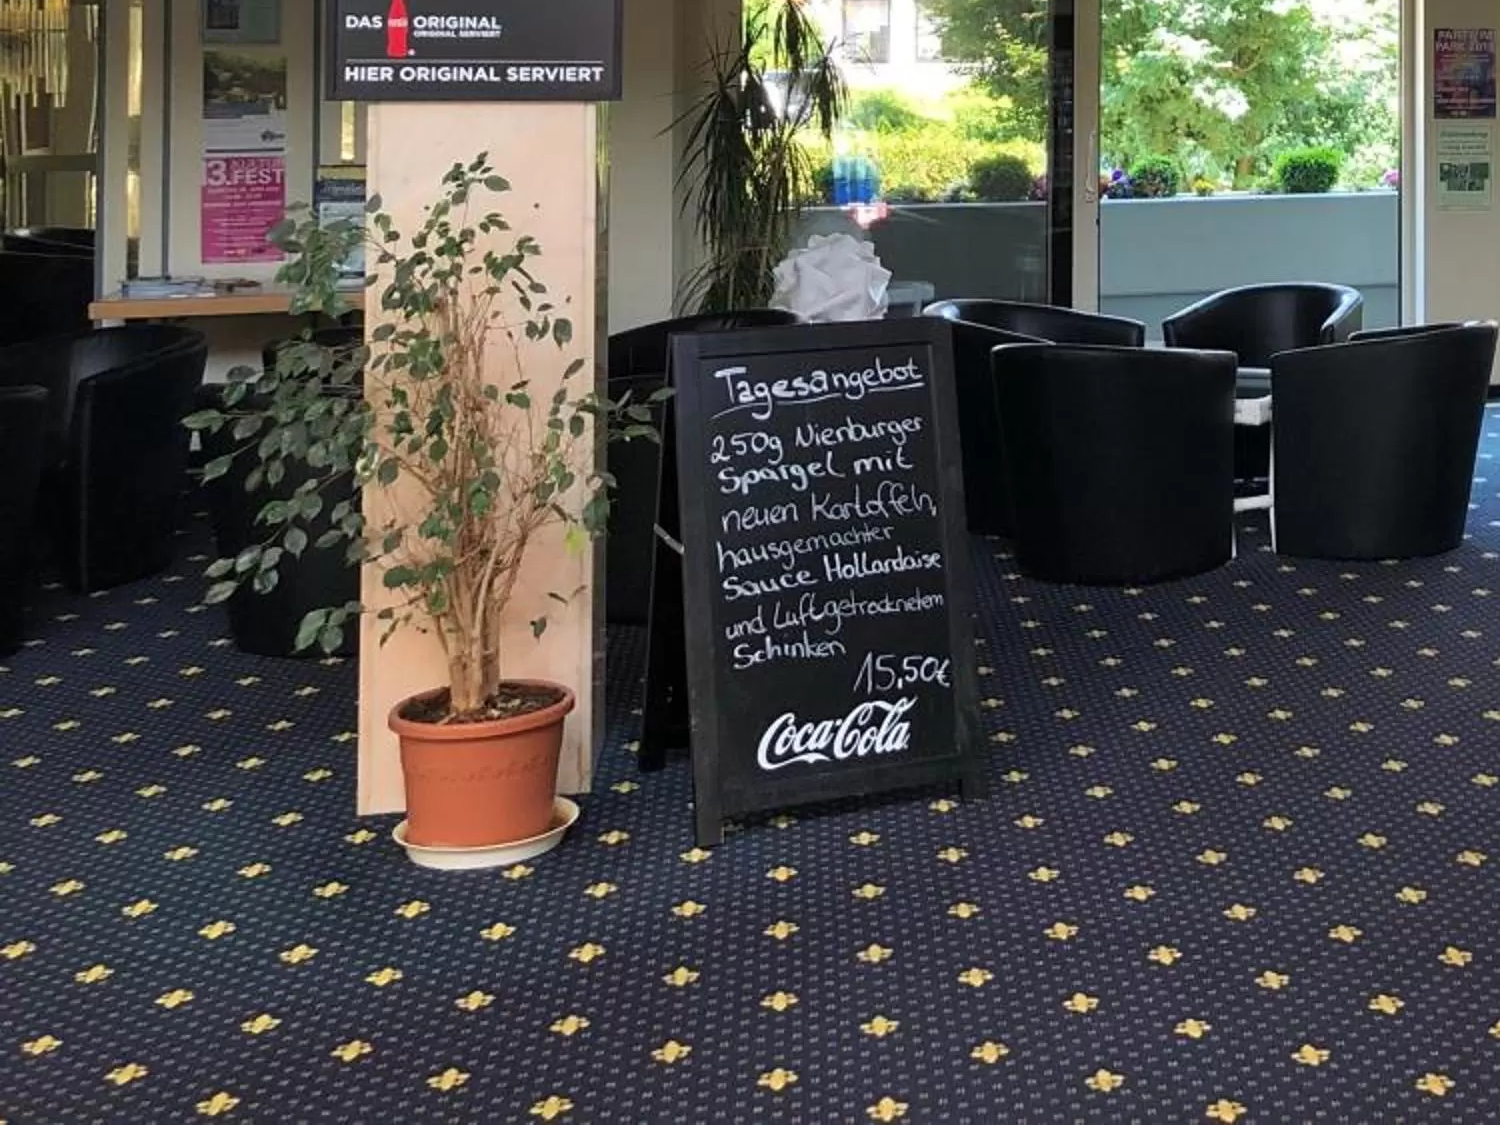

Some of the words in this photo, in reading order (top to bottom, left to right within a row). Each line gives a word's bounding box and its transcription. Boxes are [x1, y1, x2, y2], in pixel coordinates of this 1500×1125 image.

[345, 15, 383, 29] DAS
[413, 15, 501, 30] ORIGINAL
[345, 66, 394, 82] HIER
[400, 65, 500, 82] ORIGINAL
[506, 65, 604, 82] SERVIERT
[232, 168, 285, 185] FEST
[714, 356, 924, 420] Tagesangebot
[711, 431, 784, 465] 250g
[795, 415, 924, 448] Nienburger
[718, 450, 846, 495] Spargel
[853, 446, 915, 476] mit
[721, 502, 799, 532] neuen
[716, 523, 895, 573] hausgemachter
[722, 569, 820, 601] Sauce
[823, 546, 942, 582] Hollandaise
[725, 604, 768, 640] und
[733, 630, 847, 671] Schinken
[853, 650, 951, 695] 15,50€
[757, 696, 919, 771] Coca-Cola
